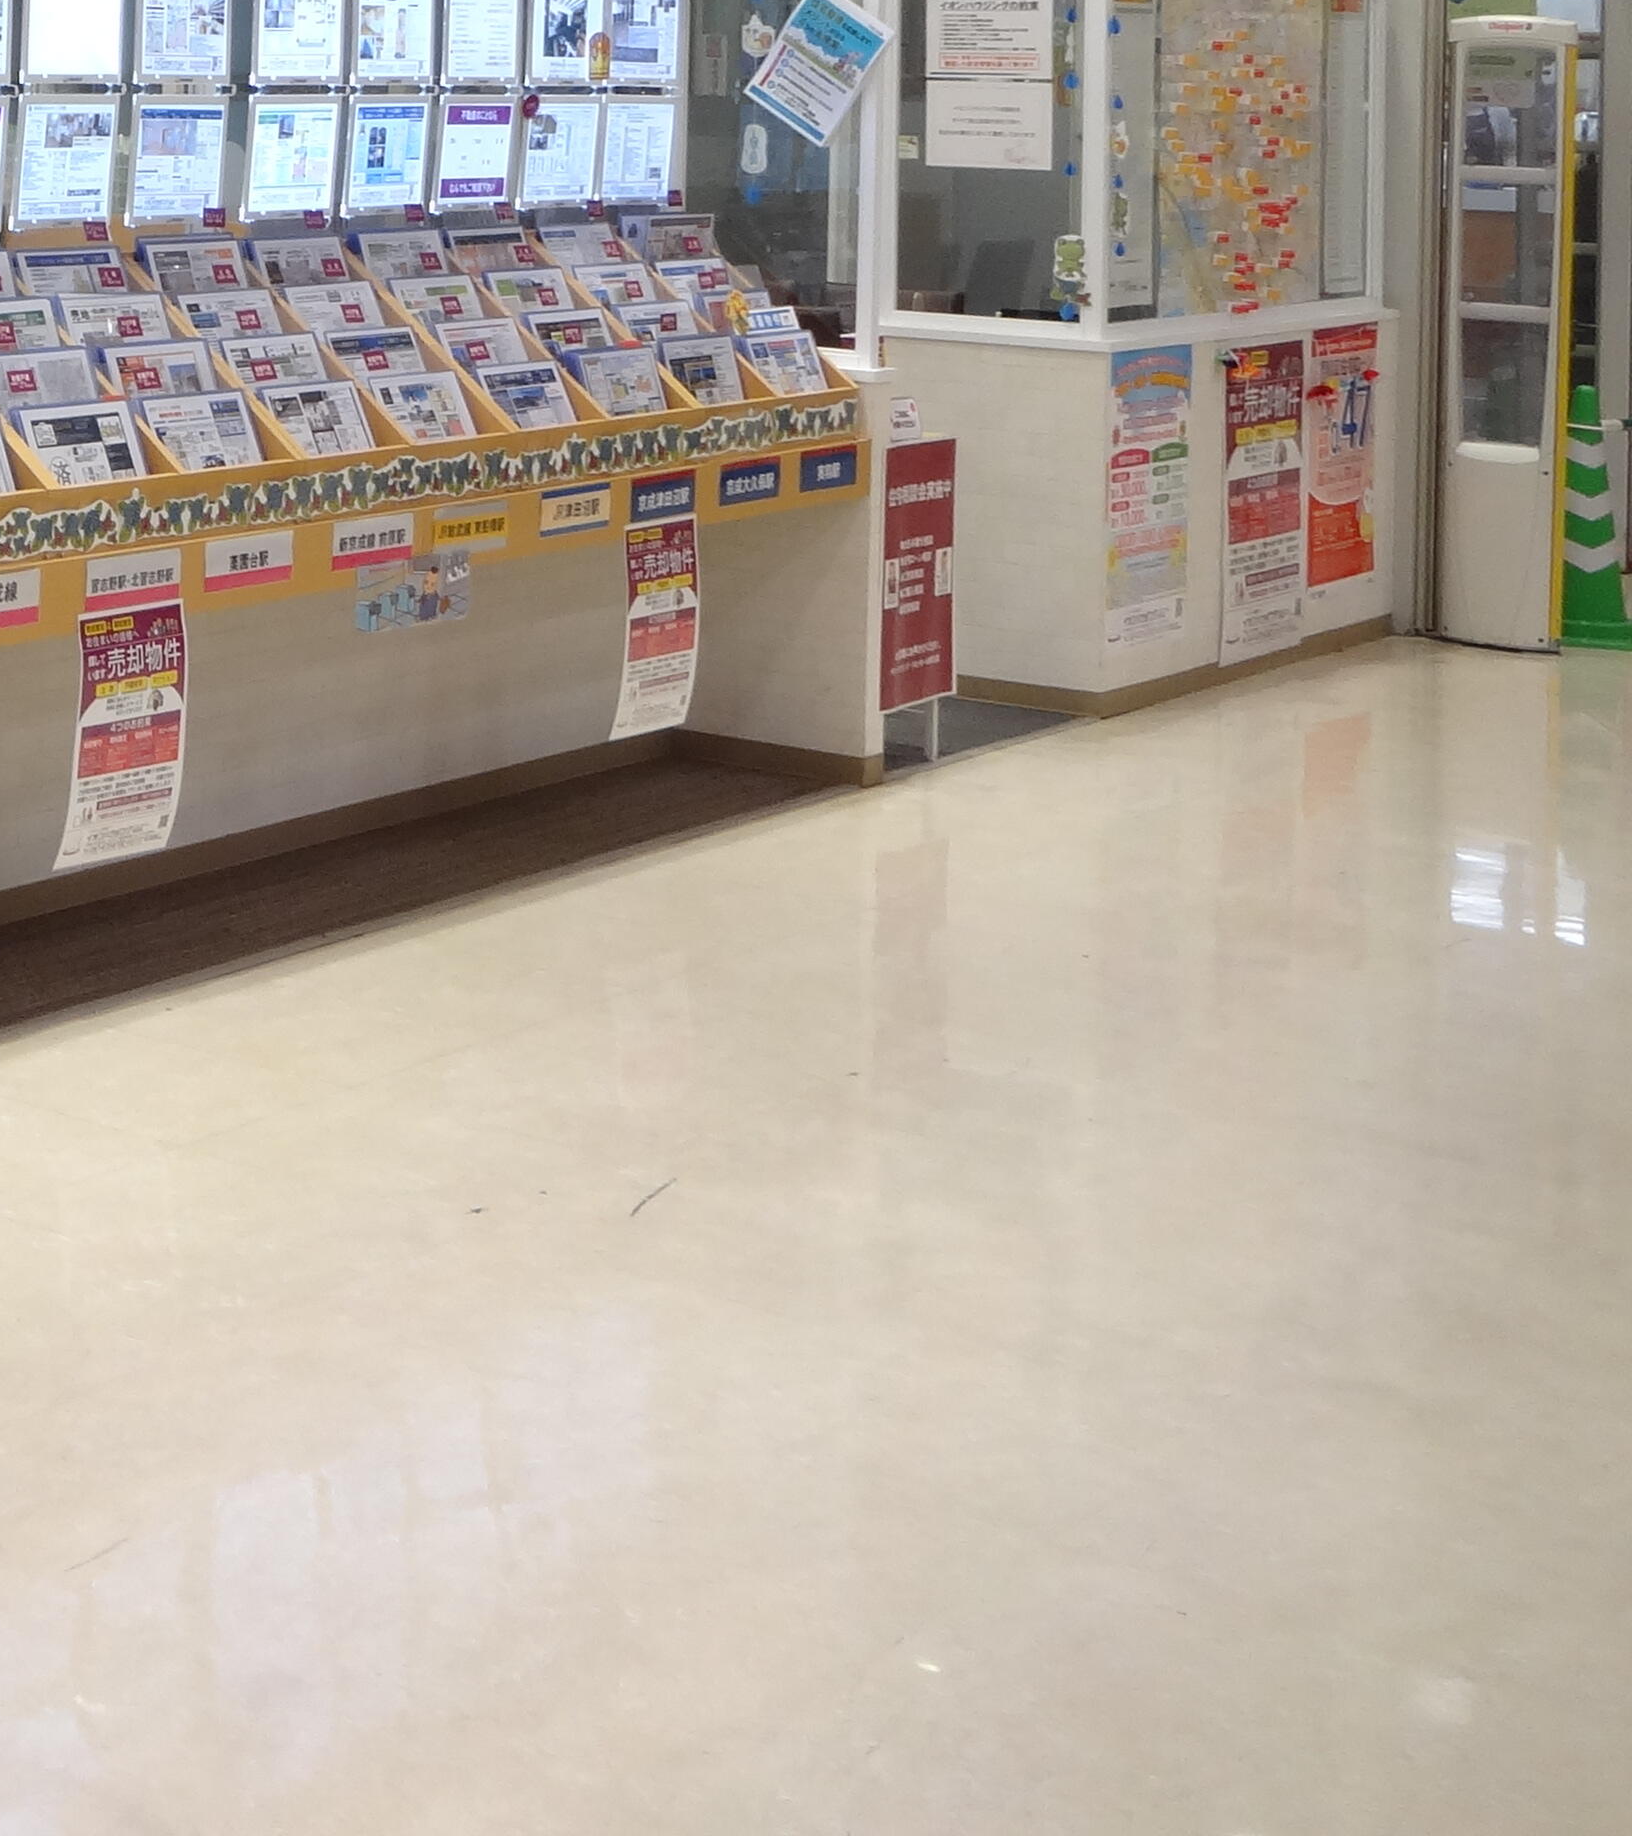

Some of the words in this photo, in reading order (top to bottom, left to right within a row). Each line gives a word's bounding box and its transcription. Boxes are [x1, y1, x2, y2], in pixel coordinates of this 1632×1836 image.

[339, 533, 375, 553] 新京成線
[643, 549, 695, 580] 売却物件
[107, 637, 181, 679] 売却物件
